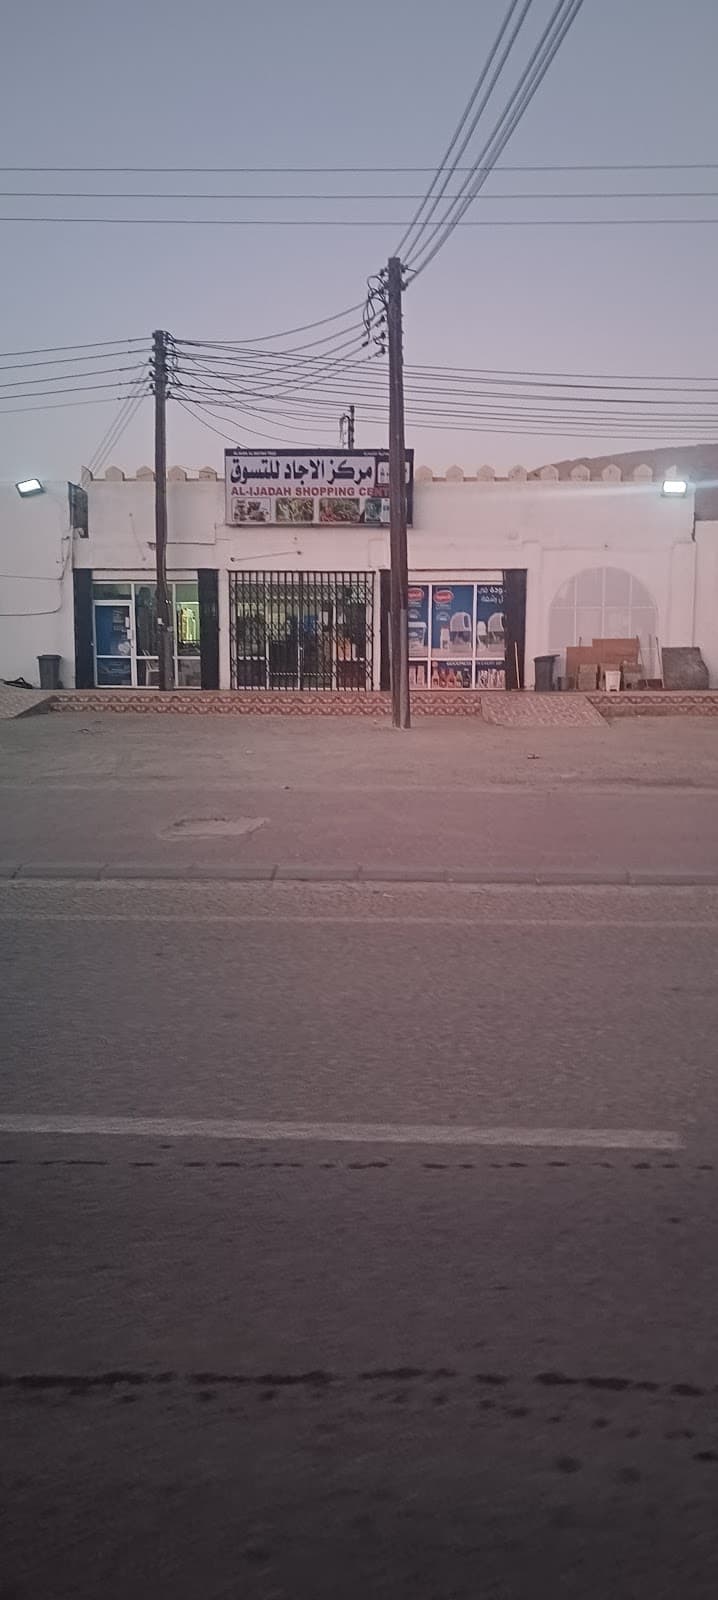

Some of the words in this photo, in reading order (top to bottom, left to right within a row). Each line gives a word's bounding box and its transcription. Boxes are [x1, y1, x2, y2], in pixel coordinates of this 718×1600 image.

[231, 459, 280, 485] للتسوق
[327, 460, 372, 485] مركز
[231, 487, 291, 497] AL-IJADAH
[295, 487, 356, 497] SHOPPING
